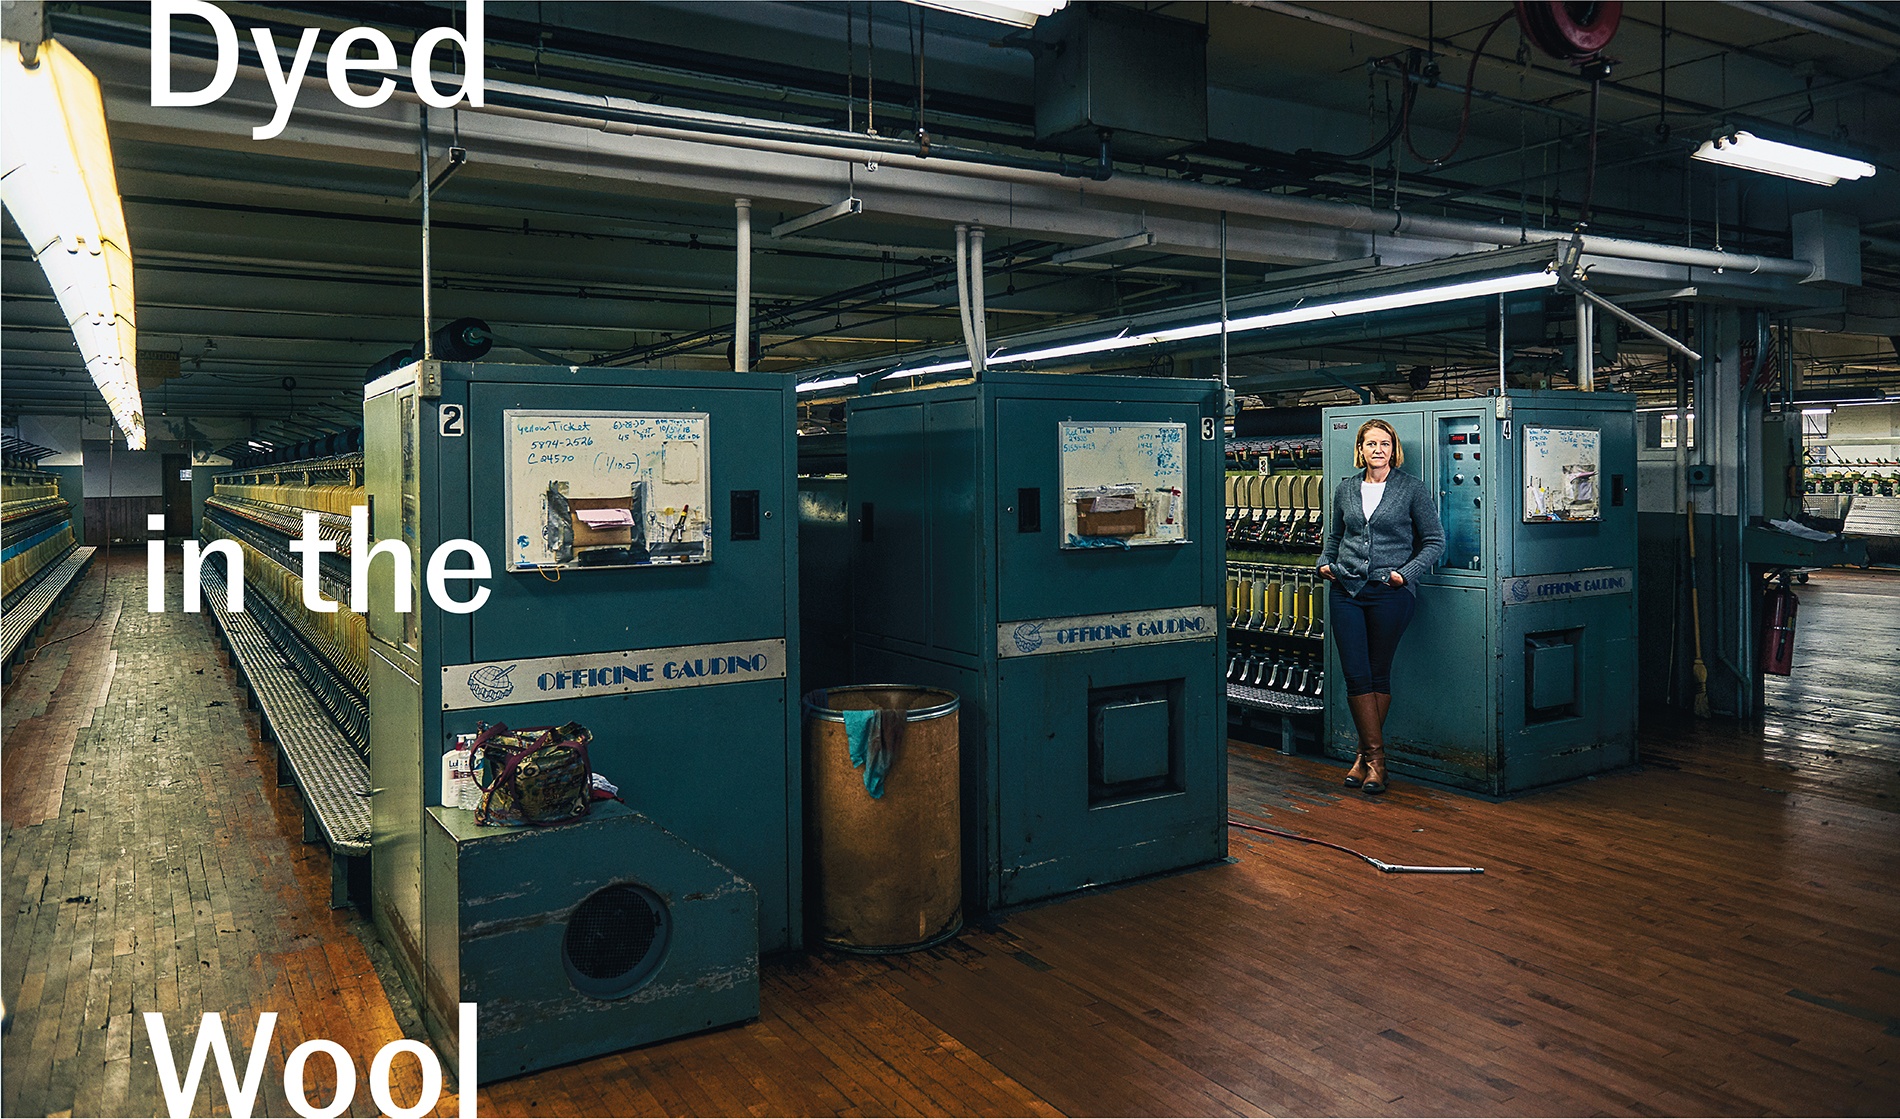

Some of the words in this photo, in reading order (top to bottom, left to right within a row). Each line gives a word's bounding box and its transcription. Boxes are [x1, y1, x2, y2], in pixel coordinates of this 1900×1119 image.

[139, 351, 178, 360] CAUTION
[443, 405, 462, 434] 2
[548, 421, 591, 431] Ticket
[1203, 418, 1213, 439] 3
[1503, 420, 1511, 439] 4
[1537, 580, 1582, 596] OFFICINE
[1584, 577, 1626, 592] GAUDINO
[1056, 624, 1132, 645] OFFICINE
[1136, 616, 1206, 637] GAUDINO
[537, 663, 654, 691] OFFICINE
[662, 653, 768, 680] GAUDINO
